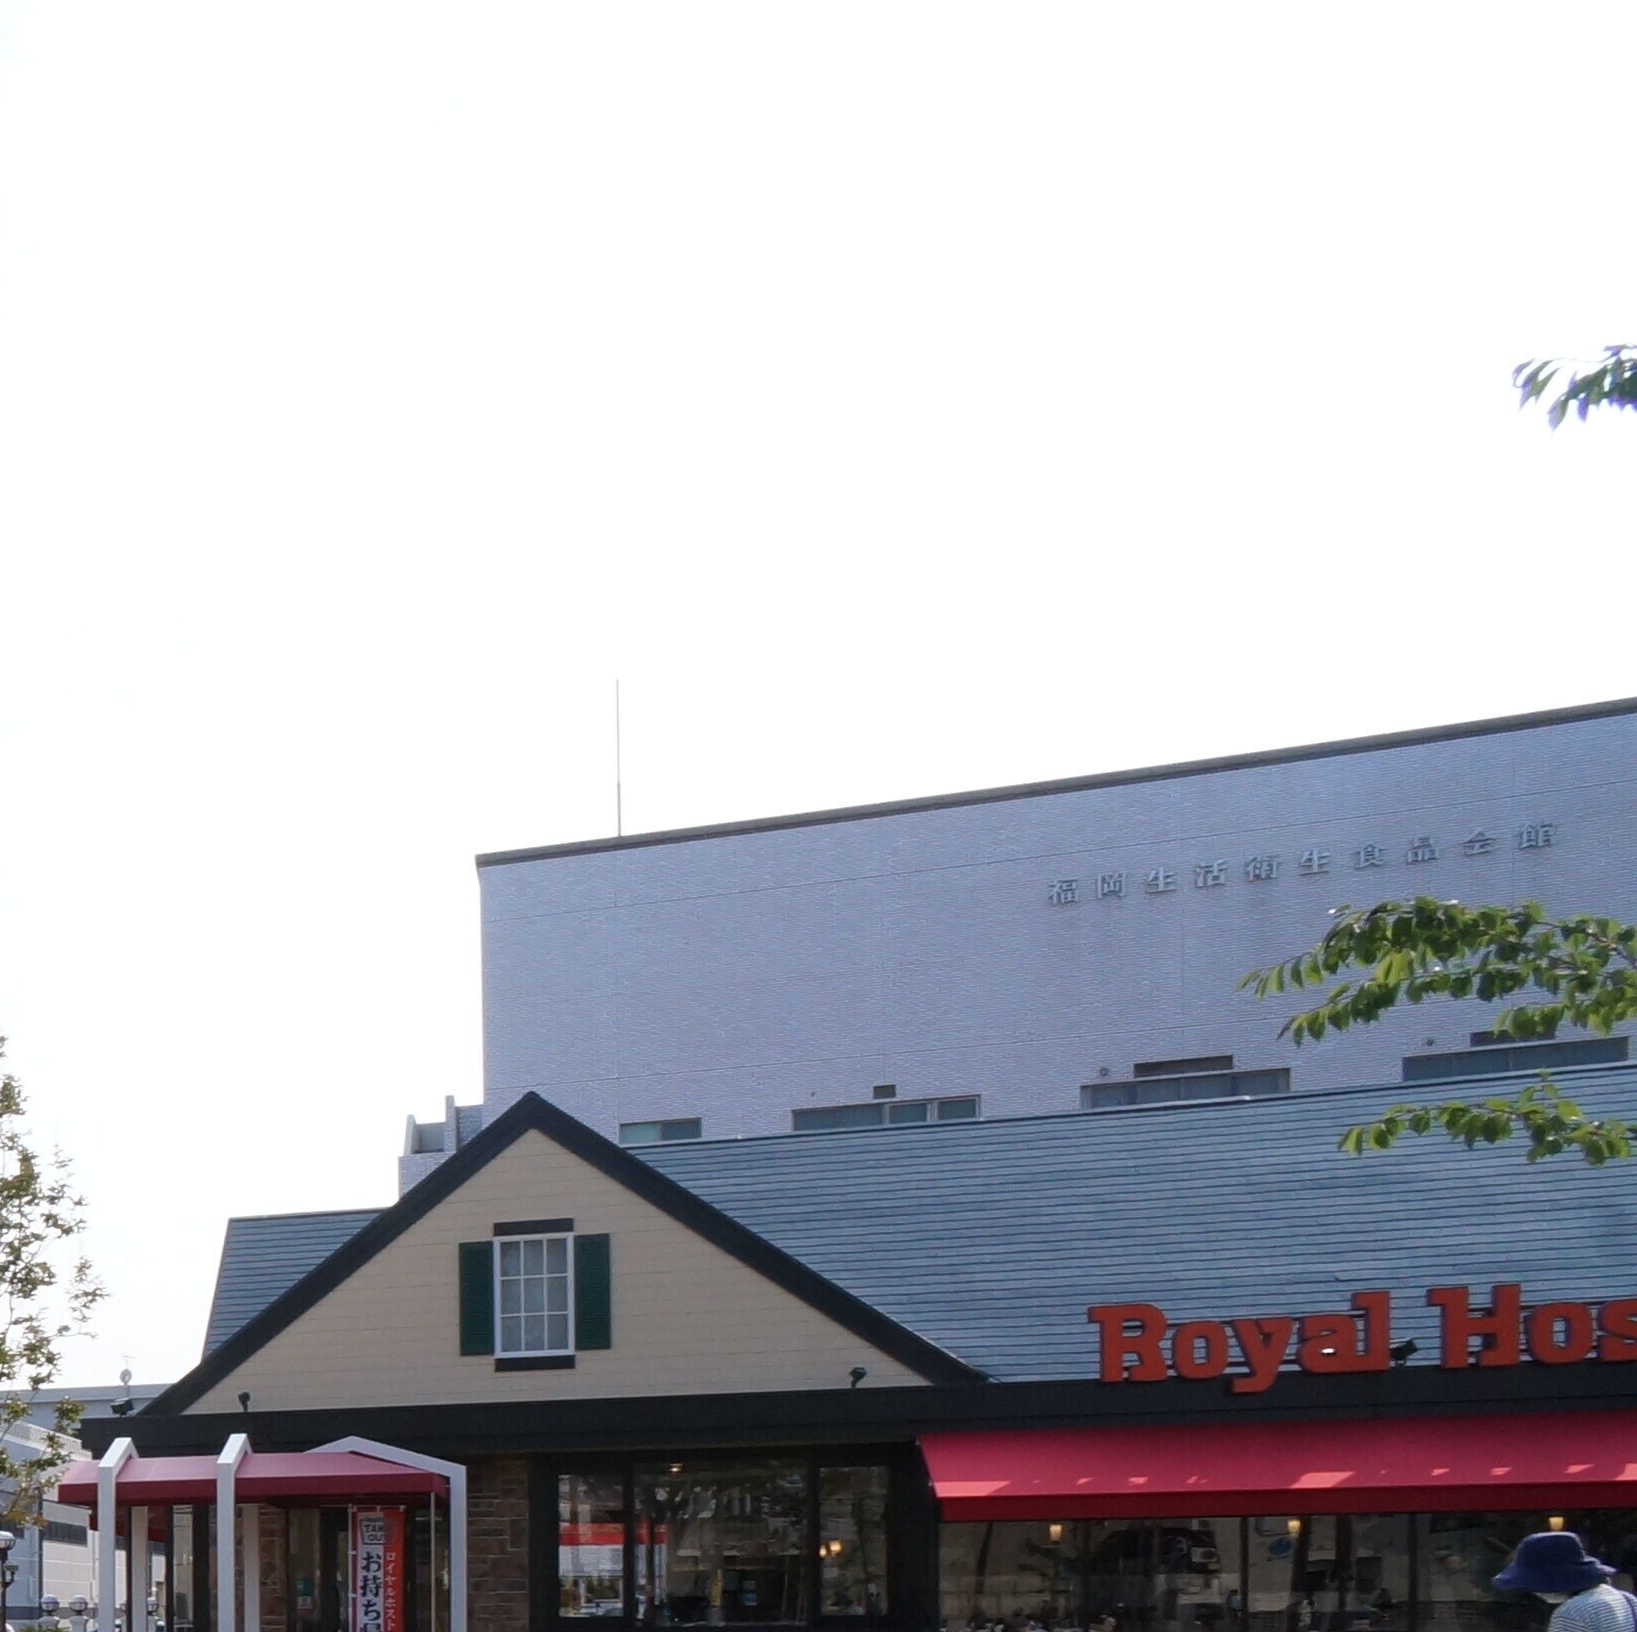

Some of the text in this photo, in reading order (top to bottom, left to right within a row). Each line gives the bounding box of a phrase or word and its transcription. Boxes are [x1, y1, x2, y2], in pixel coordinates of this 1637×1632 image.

[1047, 822, 1557, 906] 福岡生活衛生食品会館
[1087, 1290, 1391, 1393] Royal
